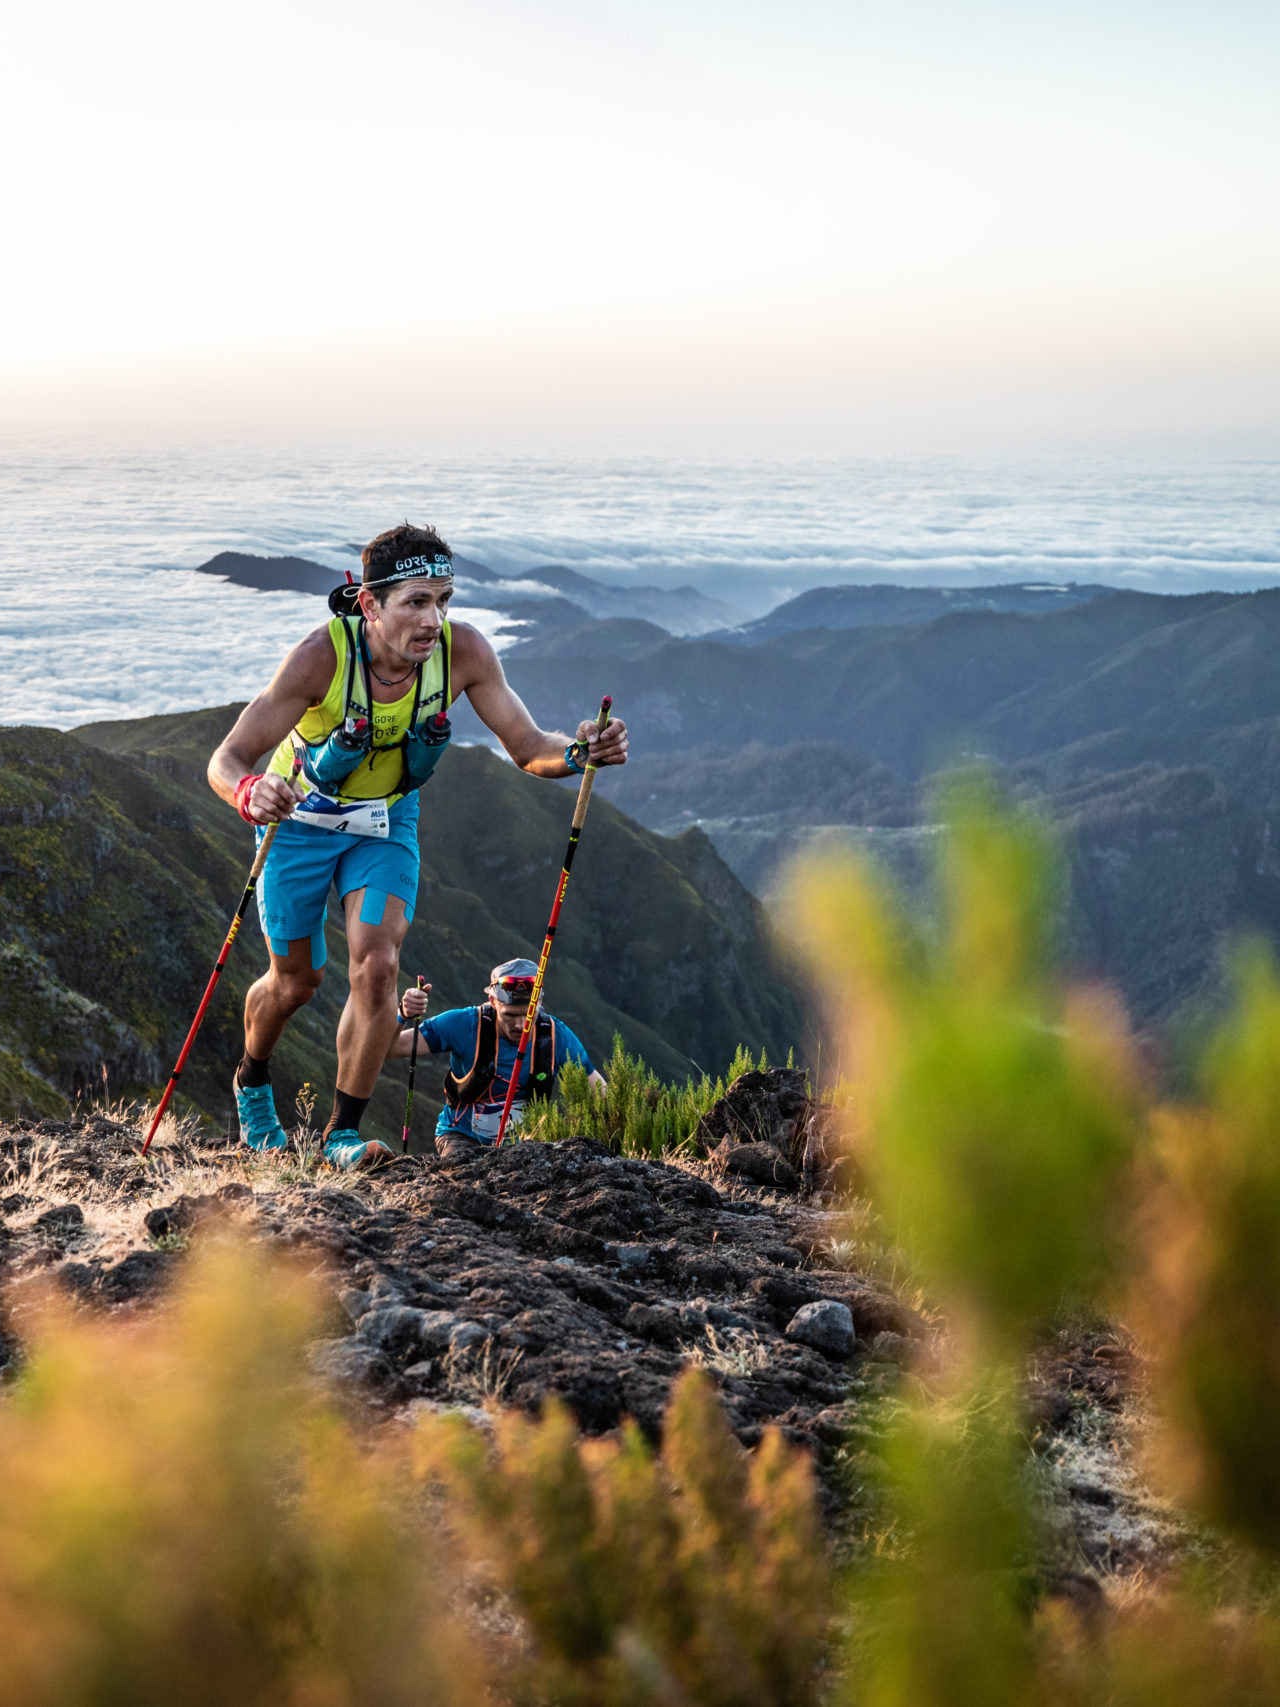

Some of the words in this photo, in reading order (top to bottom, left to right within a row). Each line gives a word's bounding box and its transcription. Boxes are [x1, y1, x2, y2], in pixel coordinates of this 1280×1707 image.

[396, 555, 427, 570] GORE
[372, 726, 399, 739] ORE
[335, 820, 349, 831] 4
[523, 939, 552, 1033] CARBON
